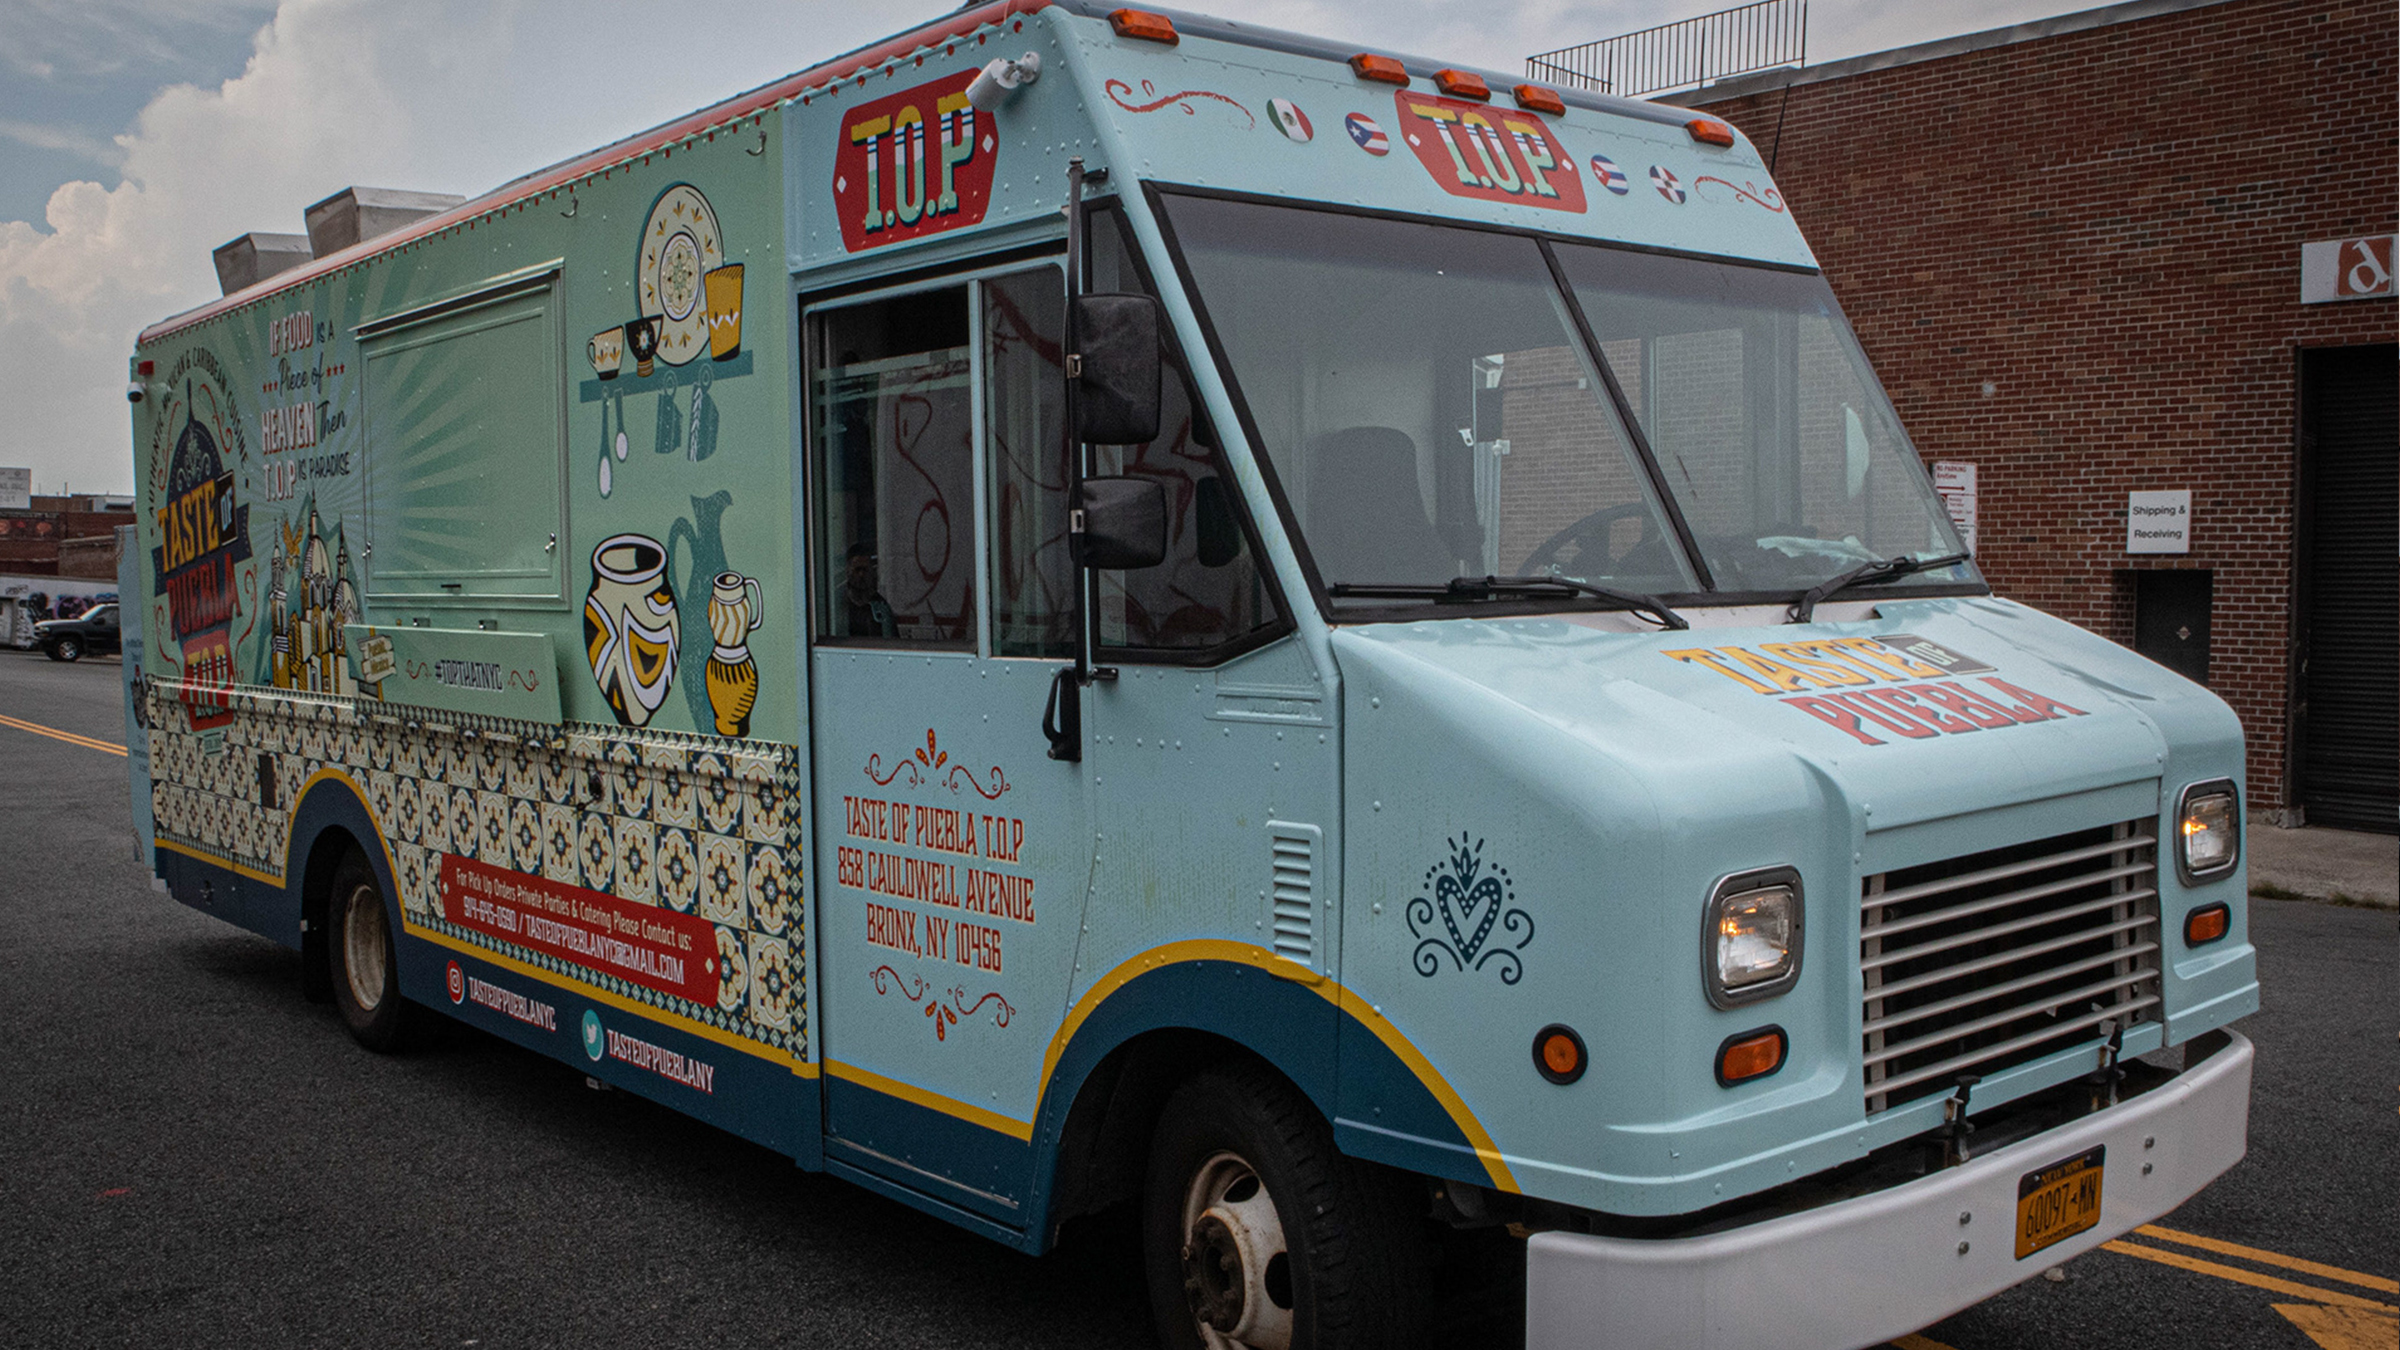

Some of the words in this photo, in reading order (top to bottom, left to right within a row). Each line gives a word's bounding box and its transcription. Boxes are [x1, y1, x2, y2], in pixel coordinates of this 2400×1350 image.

[851, 91, 976, 234] T.O.P
[1409, 103, 1560, 200] T.O.P
[269, 320, 281, 357] IF
[282, 311, 313, 353] FOOD
[316, 321, 326, 343] IS
[328, 319, 335, 340] A
[278, 357, 308, 397] Piece
[311, 351, 324, 394] of
[261, 402, 317, 455] HEAVEN
[316, 400, 348, 443] Then
[263, 459, 297, 501] T.O.P
[298, 457, 307, 480] IS
[309, 451, 351, 480] PARADISE
[157, 480, 219, 574] TASTE
[220, 486, 234, 532] OF
[2133, 505, 2176, 517] Shipping
[2178, 505, 2186, 515] &
[2134, 529, 2183, 540] Receiving
[165, 552, 242, 642] PUEBLA
[434, 659, 503, 692] #TOPTHATNYC
[1659, 636, 1953, 695] TASTE
[1904, 641, 1960, 666] OF
[1779, 676, 2091, 746] PUEBLA
[843, 795, 888, 841] TASTE
[892, 799, 911, 845] OF
[915, 804, 979, 857] PUEBLA
[982, 814, 1024, 863] T.O.P
[456, 867, 467, 887] For
[468, 870, 482, 892] Pick
[482, 875, 493, 899] Up
[494, 878, 516, 902] Orders
[517, 884, 543, 909] Private
[543, 891, 570, 917] Parties
[571, 899, 578, 918] &
[580, 901, 612, 934] Catering
[613, 910, 640, 937] Please
[642, 918, 676, 947] Contact
[678, 932, 693, 952] us:
[838, 845, 864, 889] 858
[868, 850, 961, 909] CAULDWELL
[965, 868, 1035, 924] AVENUE
[518, 912, 524, 934] /
[524, 914, 685, 985] TASTEOFPUEBLANYC@GMAIL.COM
[866, 902, 923, 960] BRONX,
[925, 914, 949, 960] NY
[954, 921, 1002, 973] 10456
[468, 976, 556, 1032] TASTEOFPUEBLANYC
[607, 1028, 714, 1095] TASTEOFPUEBLANY
